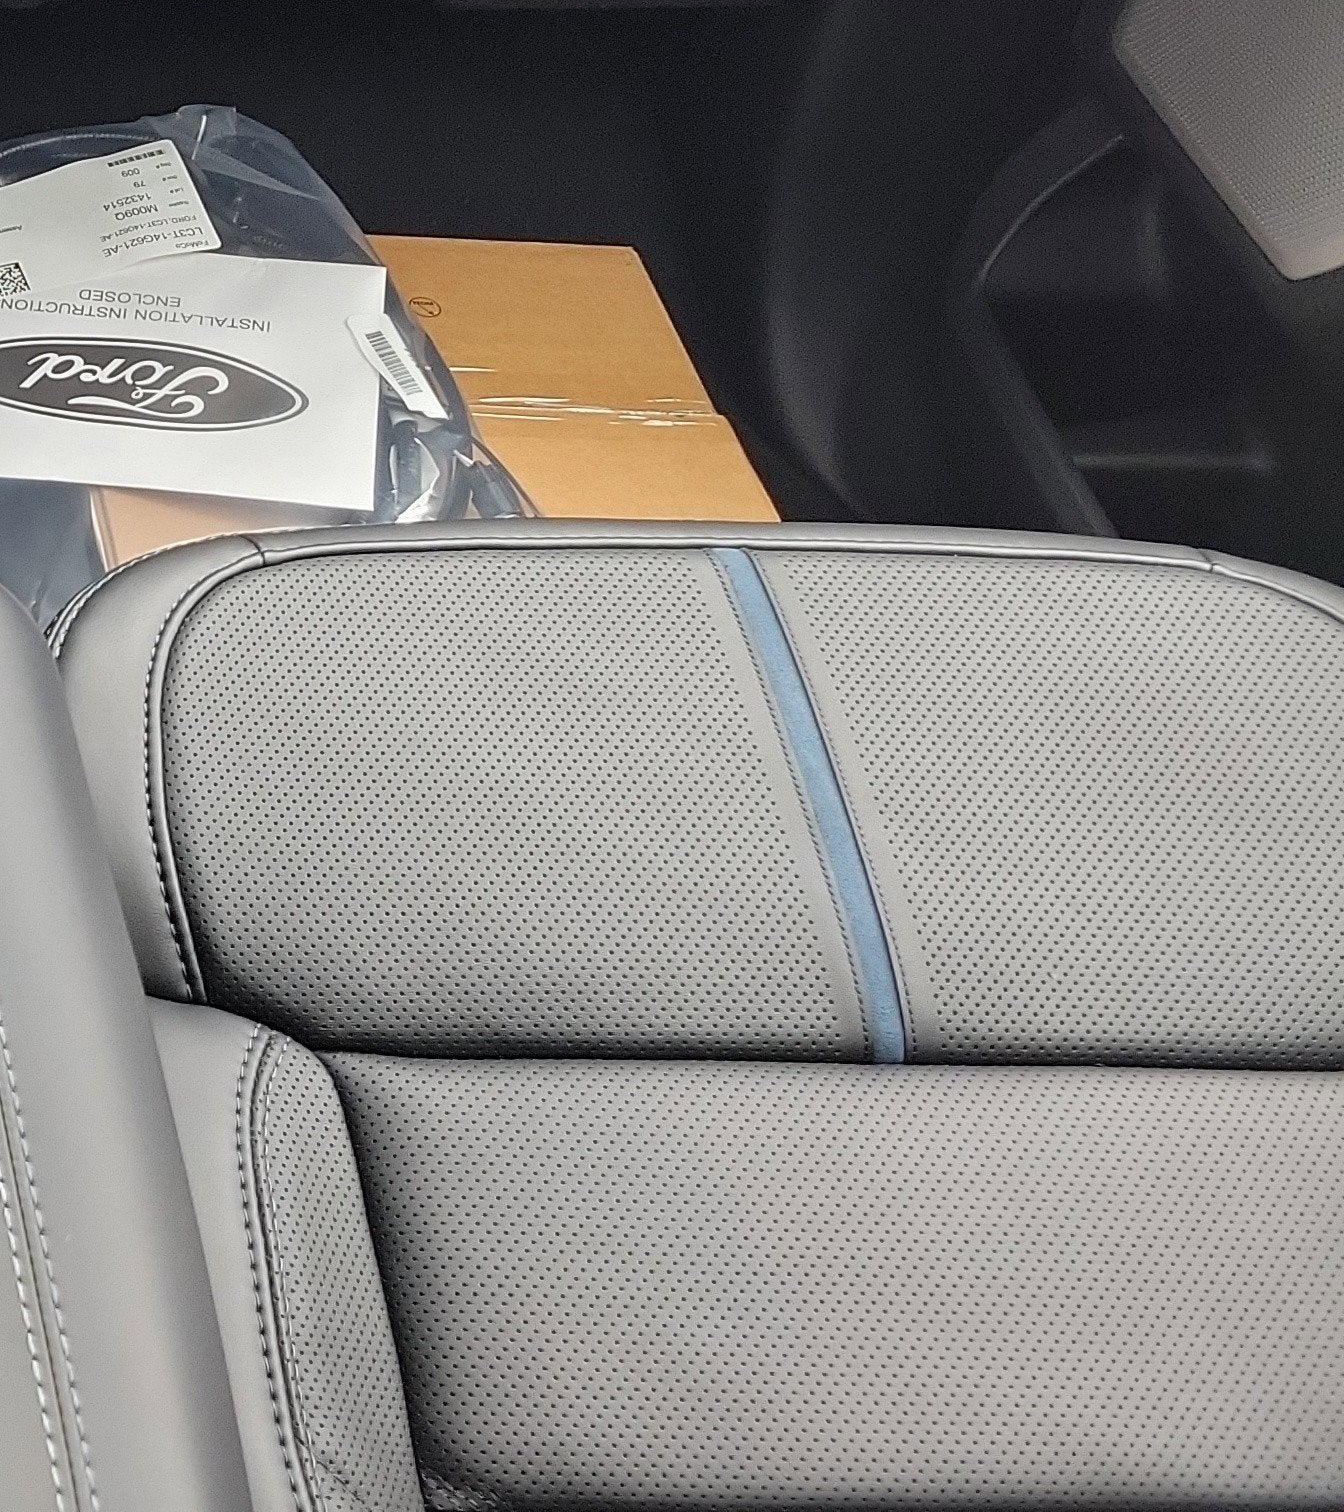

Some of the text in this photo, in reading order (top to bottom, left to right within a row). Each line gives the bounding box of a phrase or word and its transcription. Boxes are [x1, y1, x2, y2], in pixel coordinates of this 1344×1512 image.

[102, 192, 152, 211] 1432514
[114, 204, 159, 221] M009Q
[101, 226, 204, 258] LC3T-14G621-AE
[78, 289, 182, 308] ENCLOSED
[134, 308, 272, 333] INSTALLATION
[18, 350, 230, 419] Ford
